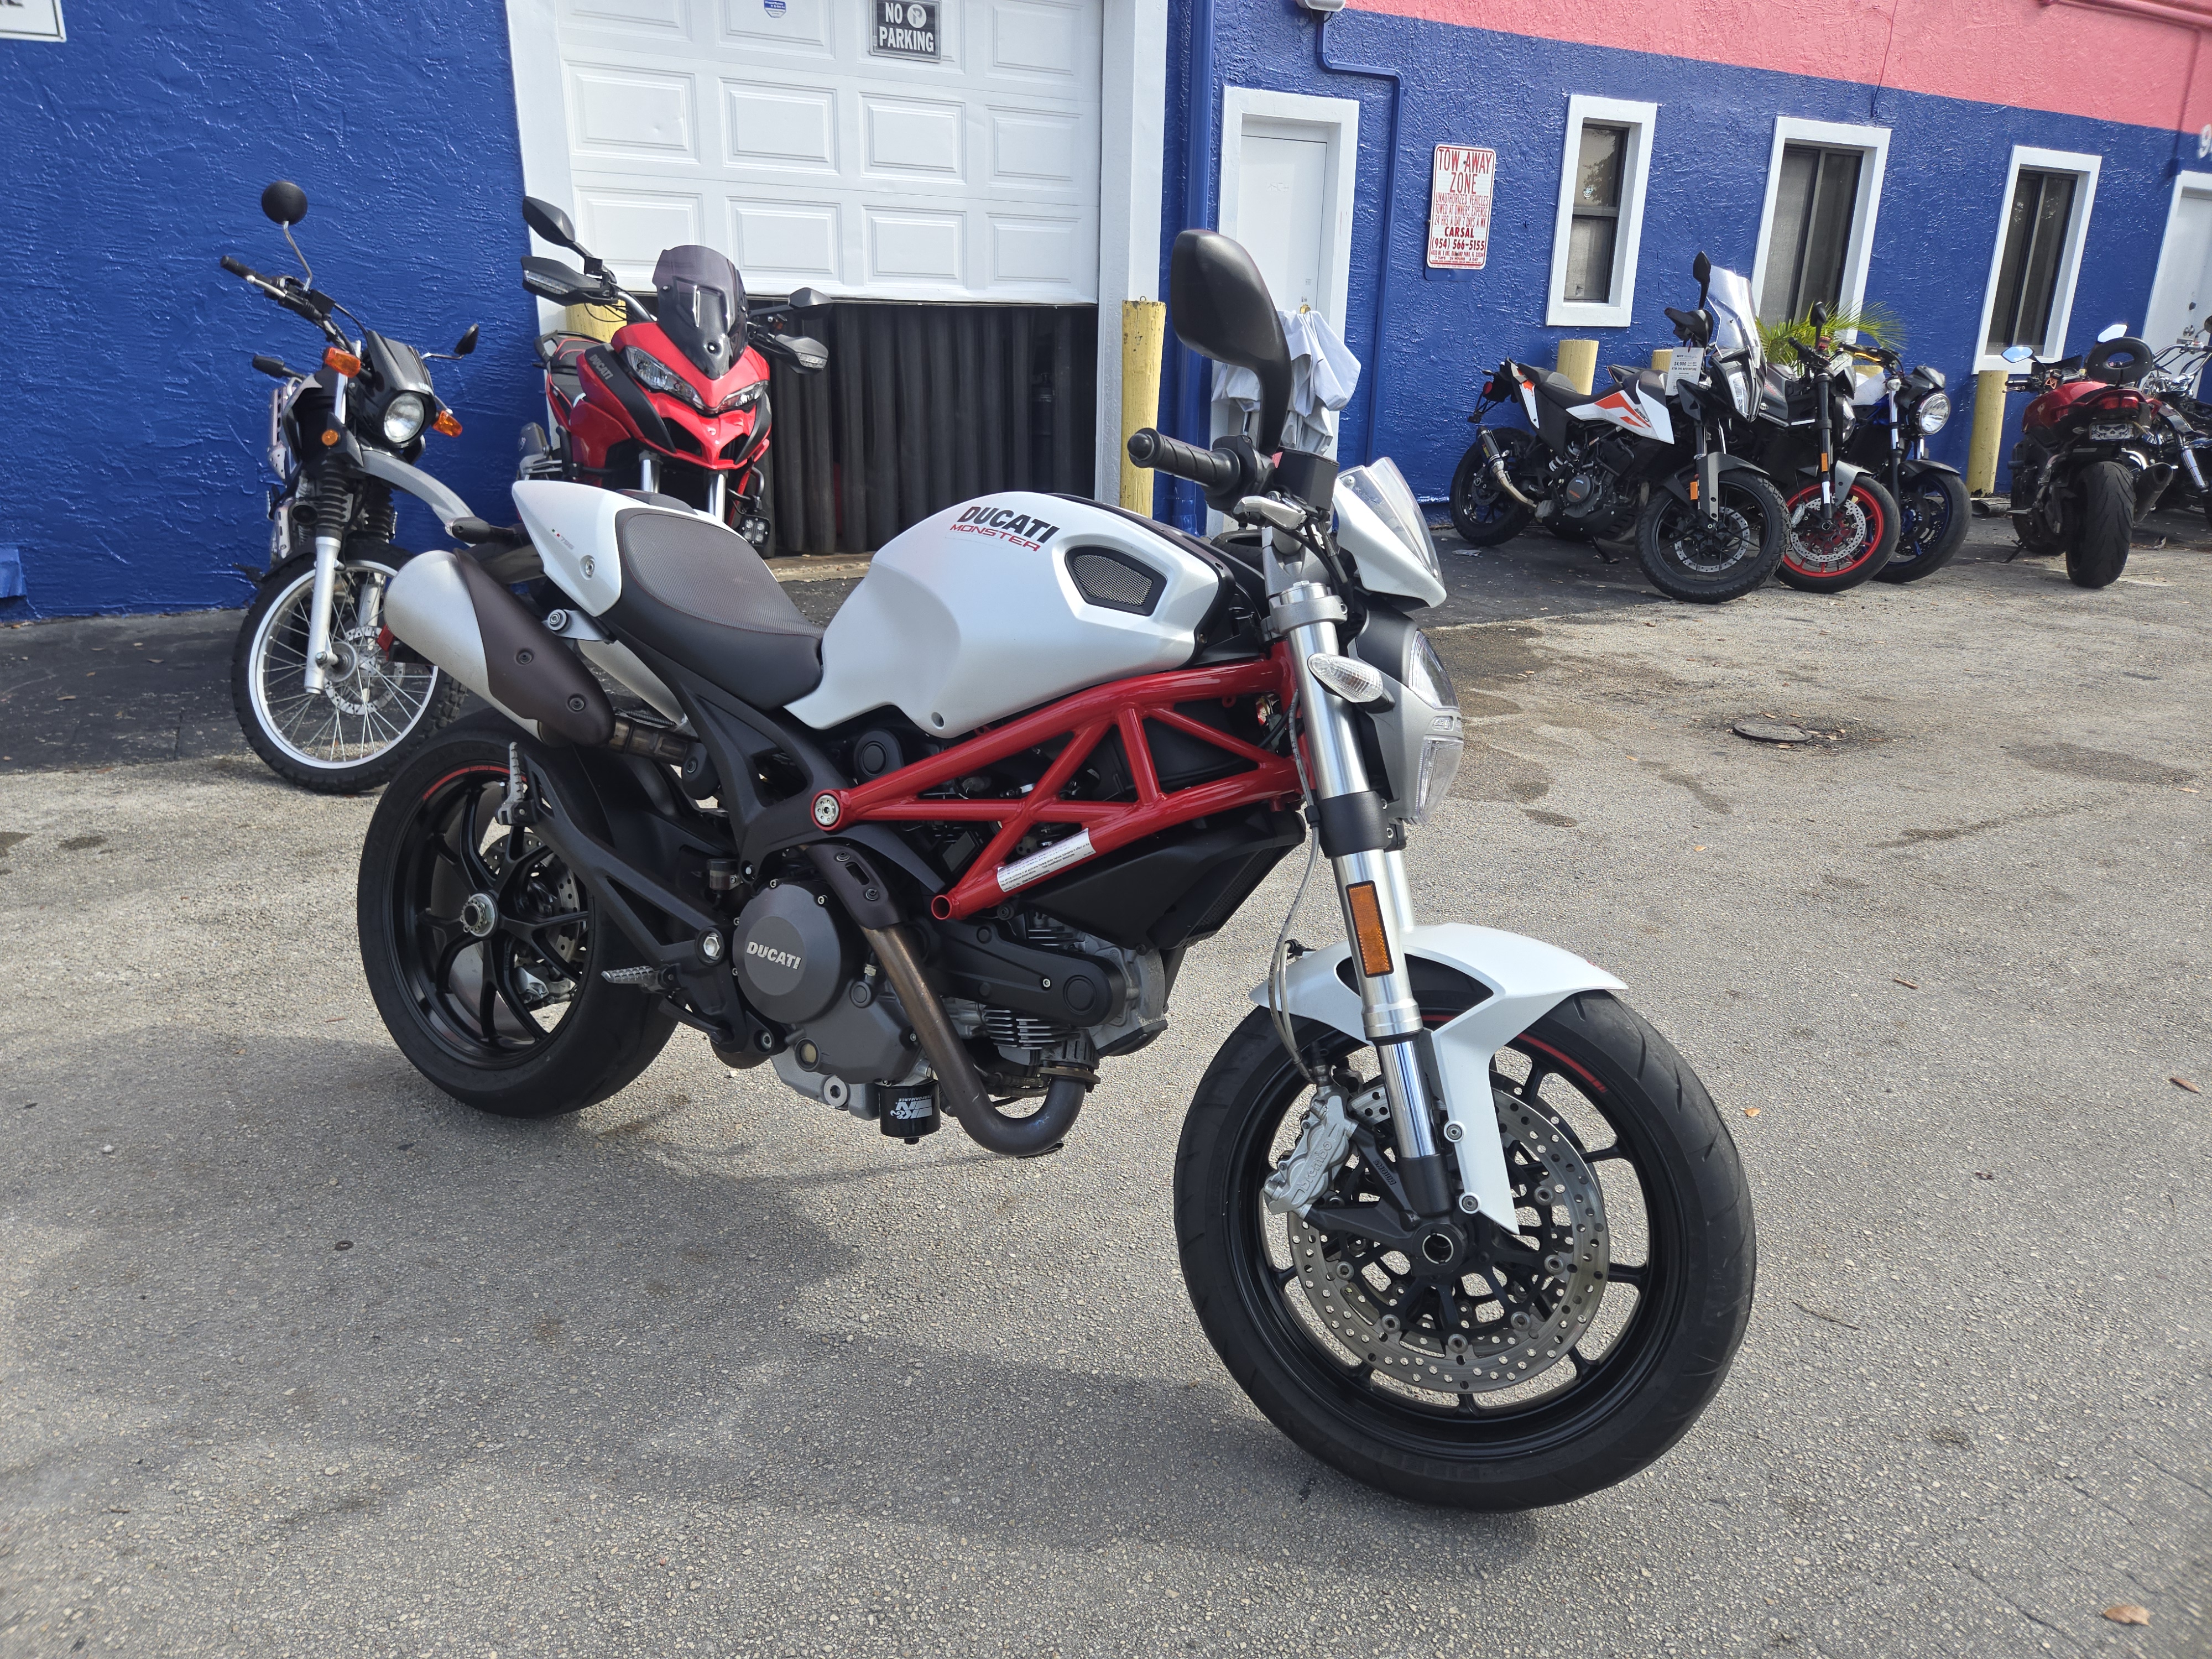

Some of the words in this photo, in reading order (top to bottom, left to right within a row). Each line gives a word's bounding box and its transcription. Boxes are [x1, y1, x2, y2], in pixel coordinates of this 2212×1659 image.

[885, 2, 902, 24] NO
[879, 26, 934, 53] PARKING
[1439, 149, 1460, 171] TOW
[1464, 152, 1492, 174] AWAY
[1450, 172, 1478, 194] ZONE
[1435, 204, 1448, 215] TOWED
[1449, 204, 1454, 215] AT
[1472, 206, 1488, 217] EXPENSE
[1436, 192, 1468, 205] UNAUTHORIZED
[1470, 195, 1489, 207] VEHICLES
[1434, 215, 1439, 226] 24
[1450, 215, 1453, 226] A
[1463, 216, 1465, 227] 7
[1466, 217, 1475, 228] DAYS
[1477, 217, 1479, 228] A
[1444, 226, 1474, 238] CARSAL
[1432, 237, 1450, 251] (954)
[1452, 239, 1485, 251] 566-5155
[589, 354, 614, 380] DUCATI
[950, 524, 1041, 552] MONSTER
[957, 507, 1060, 544] DUCATI
[747, 941, 801, 969] DUCATI
[1297, 1141, 1333, 1191] brembo
[1374, 1159, 1397, 1185] SHOWA
